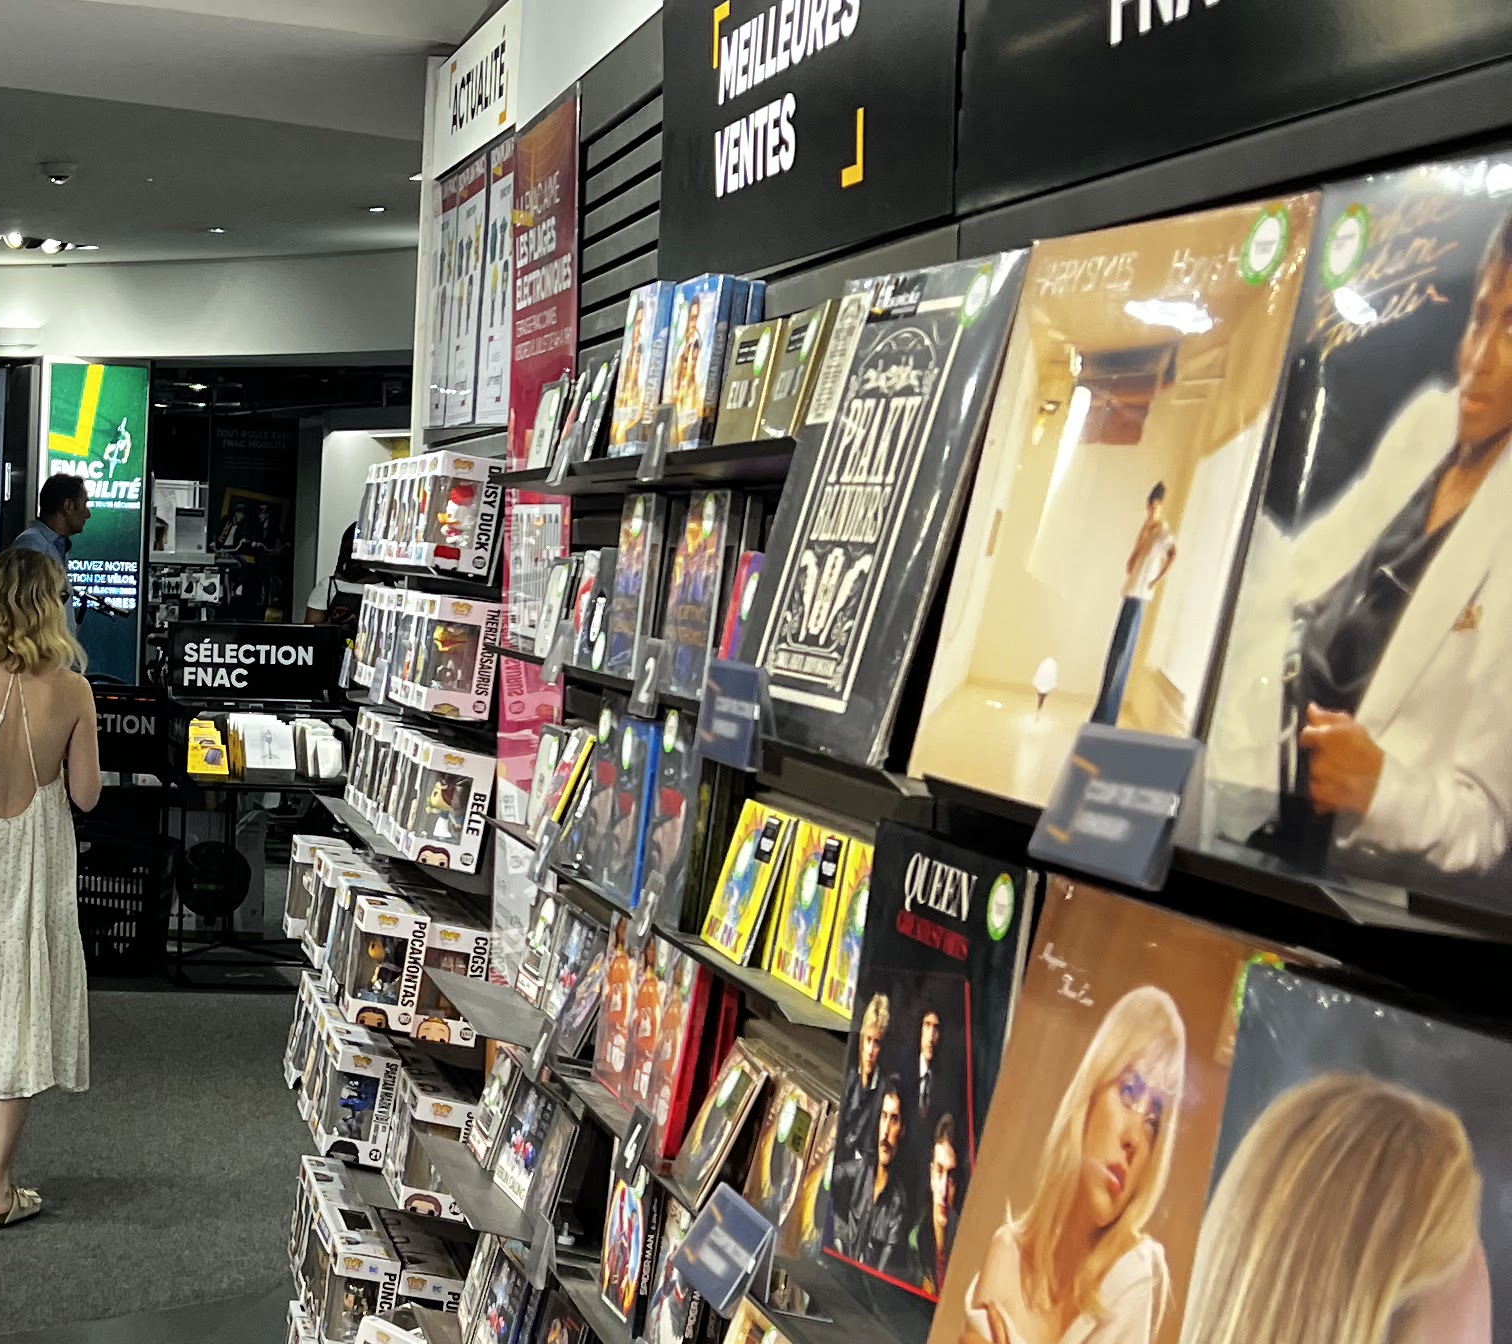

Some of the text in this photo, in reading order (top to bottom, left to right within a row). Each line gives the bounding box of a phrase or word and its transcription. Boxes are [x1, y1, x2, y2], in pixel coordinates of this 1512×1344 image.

[450, 24, 508, 136] ACTUALITÉ
[713, 92, 797, 199] VENTES
[827, 394, 923, 485] PEAKY
[50, 459, 104, 479] FNAC
[474, 512, 495, 553] DUCK
[105, 560, 138, 573] NOTRE
[183, 638, 314, 666] SÉLECTION
[183, 667, 249, 689] FNAC
[466, 791, 488, 837] BELLE
[904, 851, 979, 922] QUEEN
[399, 920, 428, 1008] POCAHONTAS
